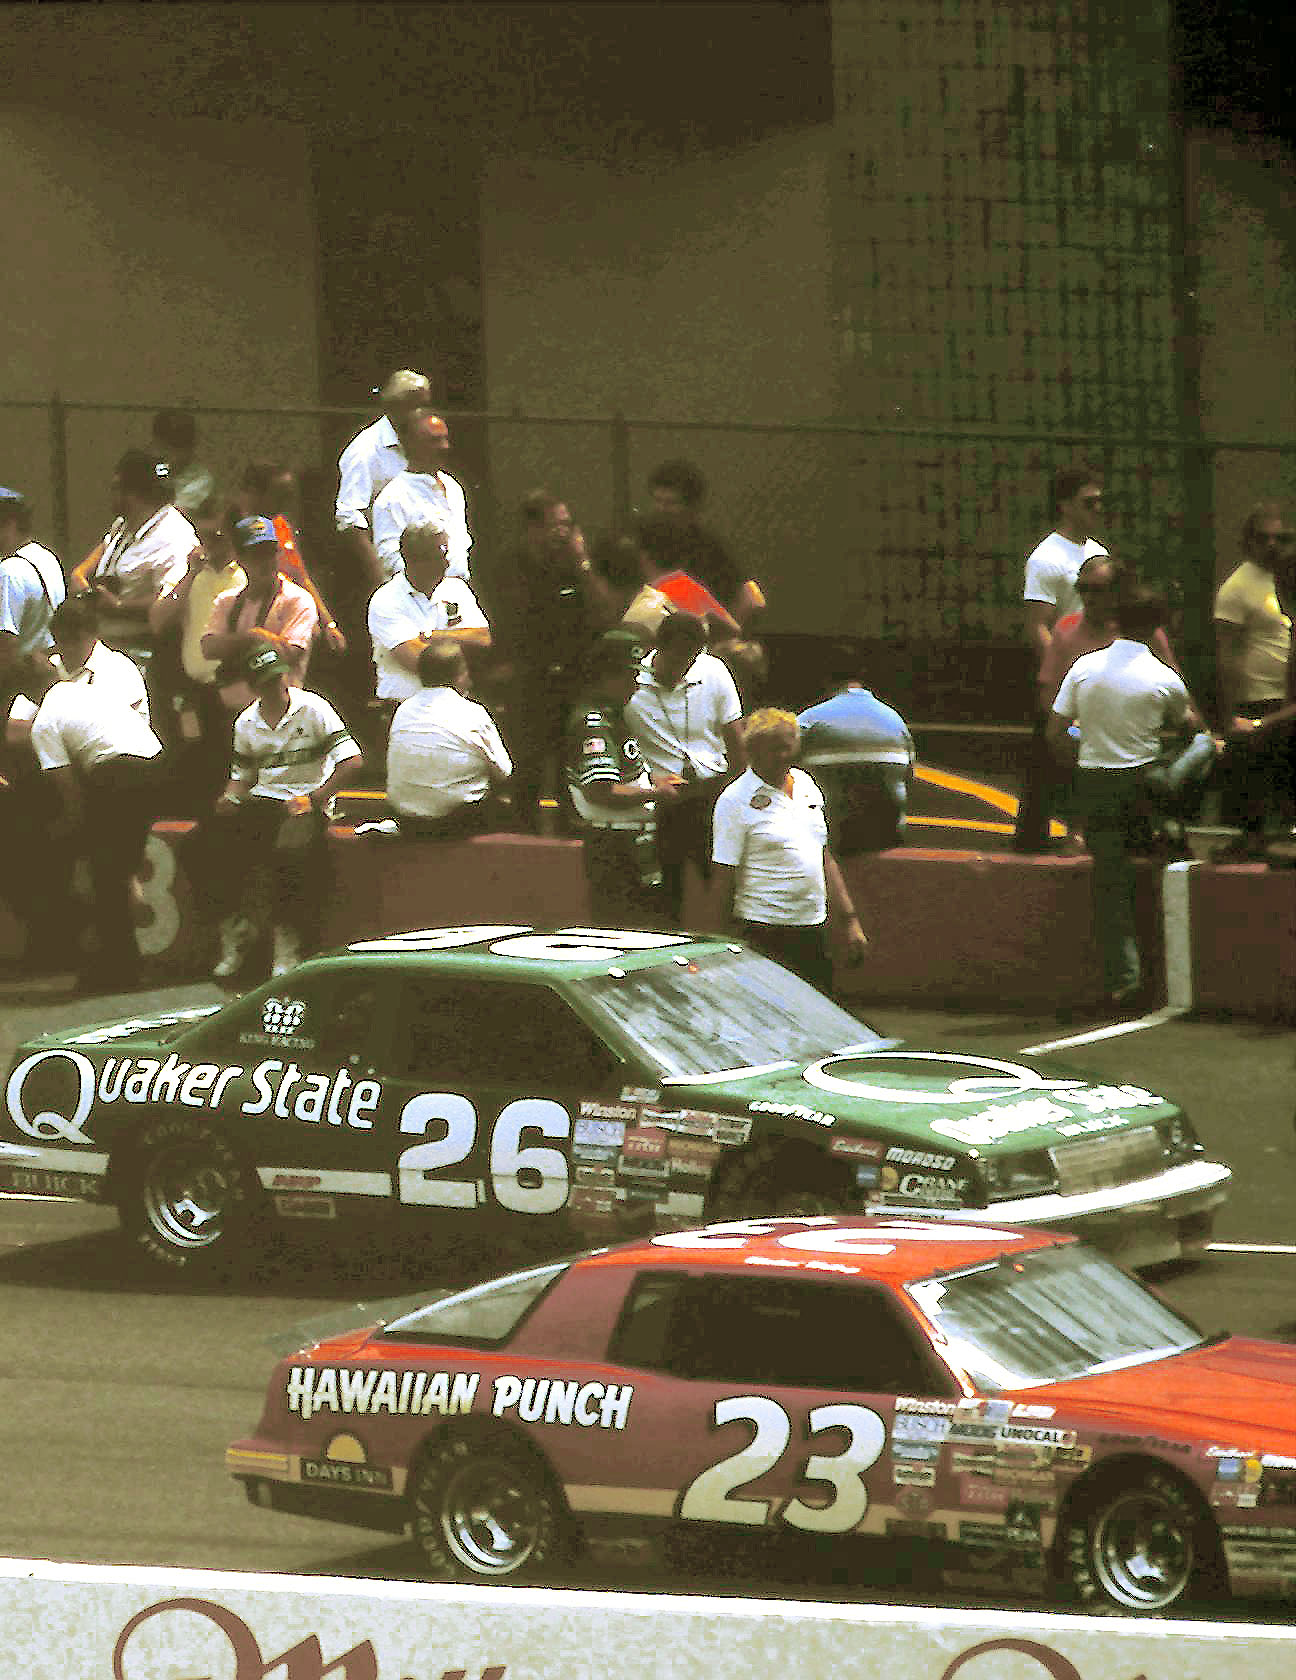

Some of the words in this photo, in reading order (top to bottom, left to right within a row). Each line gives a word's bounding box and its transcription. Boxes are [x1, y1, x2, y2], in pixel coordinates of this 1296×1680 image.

[5, 1048, 244, 1145] Quaker
[240, 1058, 381, 1130] State
[579, 1101, 637, 1120] Winston
[398, 1092, 571, 1215] 26
[886, 1147, 956, 1171] MOROSO
[11, 1172, 99, 1194] BUICK
[287, 1367, 480, 1420] HAWAIIAN
[492, 1374, 635, 1431] PUNCH
[894, 1397, 956, 1416] Winston
[1000, 1427, 1059, 1443] UNOCAL
[306, 1461, 354, 1482] DAYS
[679, 1395, 886, 1532] 23
